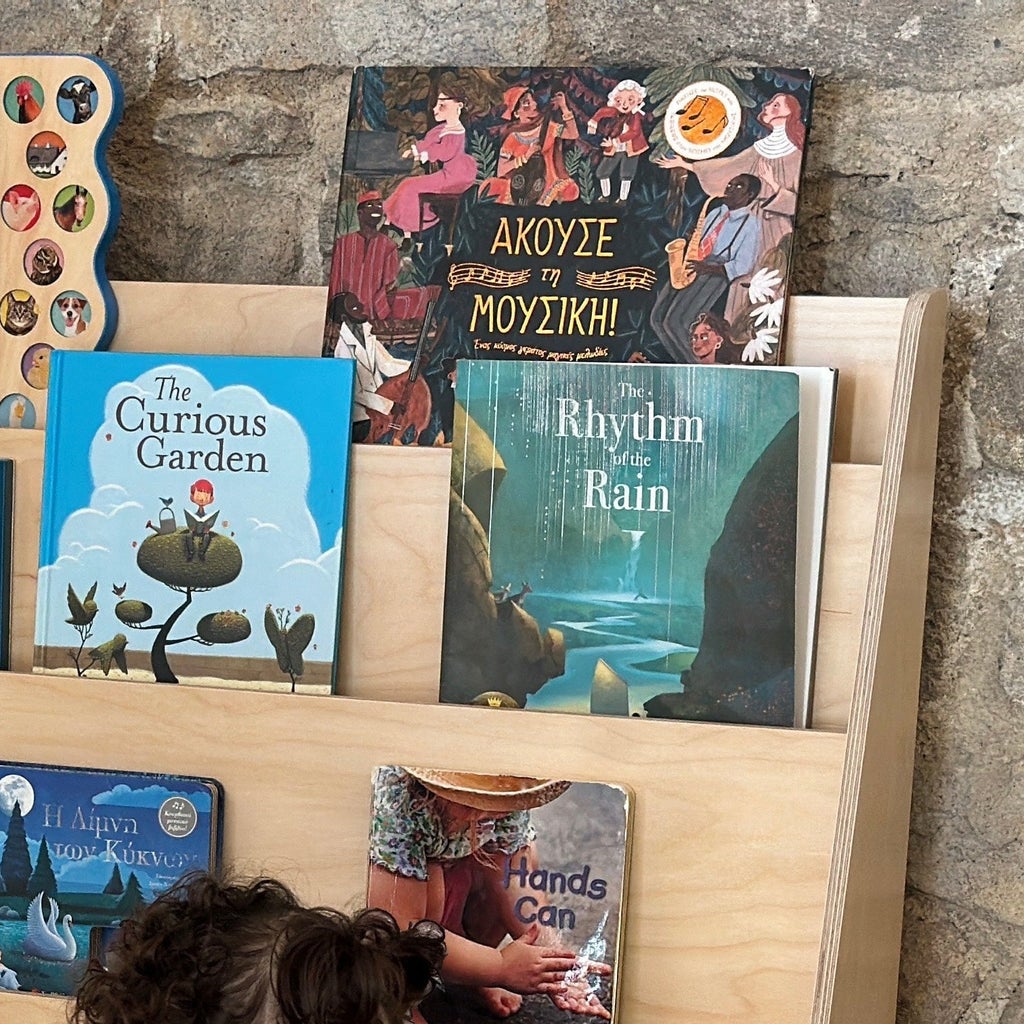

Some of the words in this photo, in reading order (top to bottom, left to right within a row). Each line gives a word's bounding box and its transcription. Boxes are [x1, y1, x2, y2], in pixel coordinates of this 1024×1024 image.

[490, 217, 618, 257] ΑΚΟΥΣΕ
[541, 268, 561, 287] τη
[469, 295, 619, 336] ΜΟΥΣΙΚΗ!
[154, 375, 192, 402] The
[618, 382, 645, 399] The
[115, 396, 267, 437] Curious
[555, 397, 704, 452] Rhythm
[136, 435, 269, 473] Garden
[613, 453, 628, 467] of
[630, 453, 651, 467] the
[583, 468, 671, 513] Rain
[42, 803, 63, 828] Η
[70, 805, 139, 840] Λίμνη
[53, 843, 96, 861] των
[503, 856, 608, 900] Hands
[515, 895, 576, 930] Can
